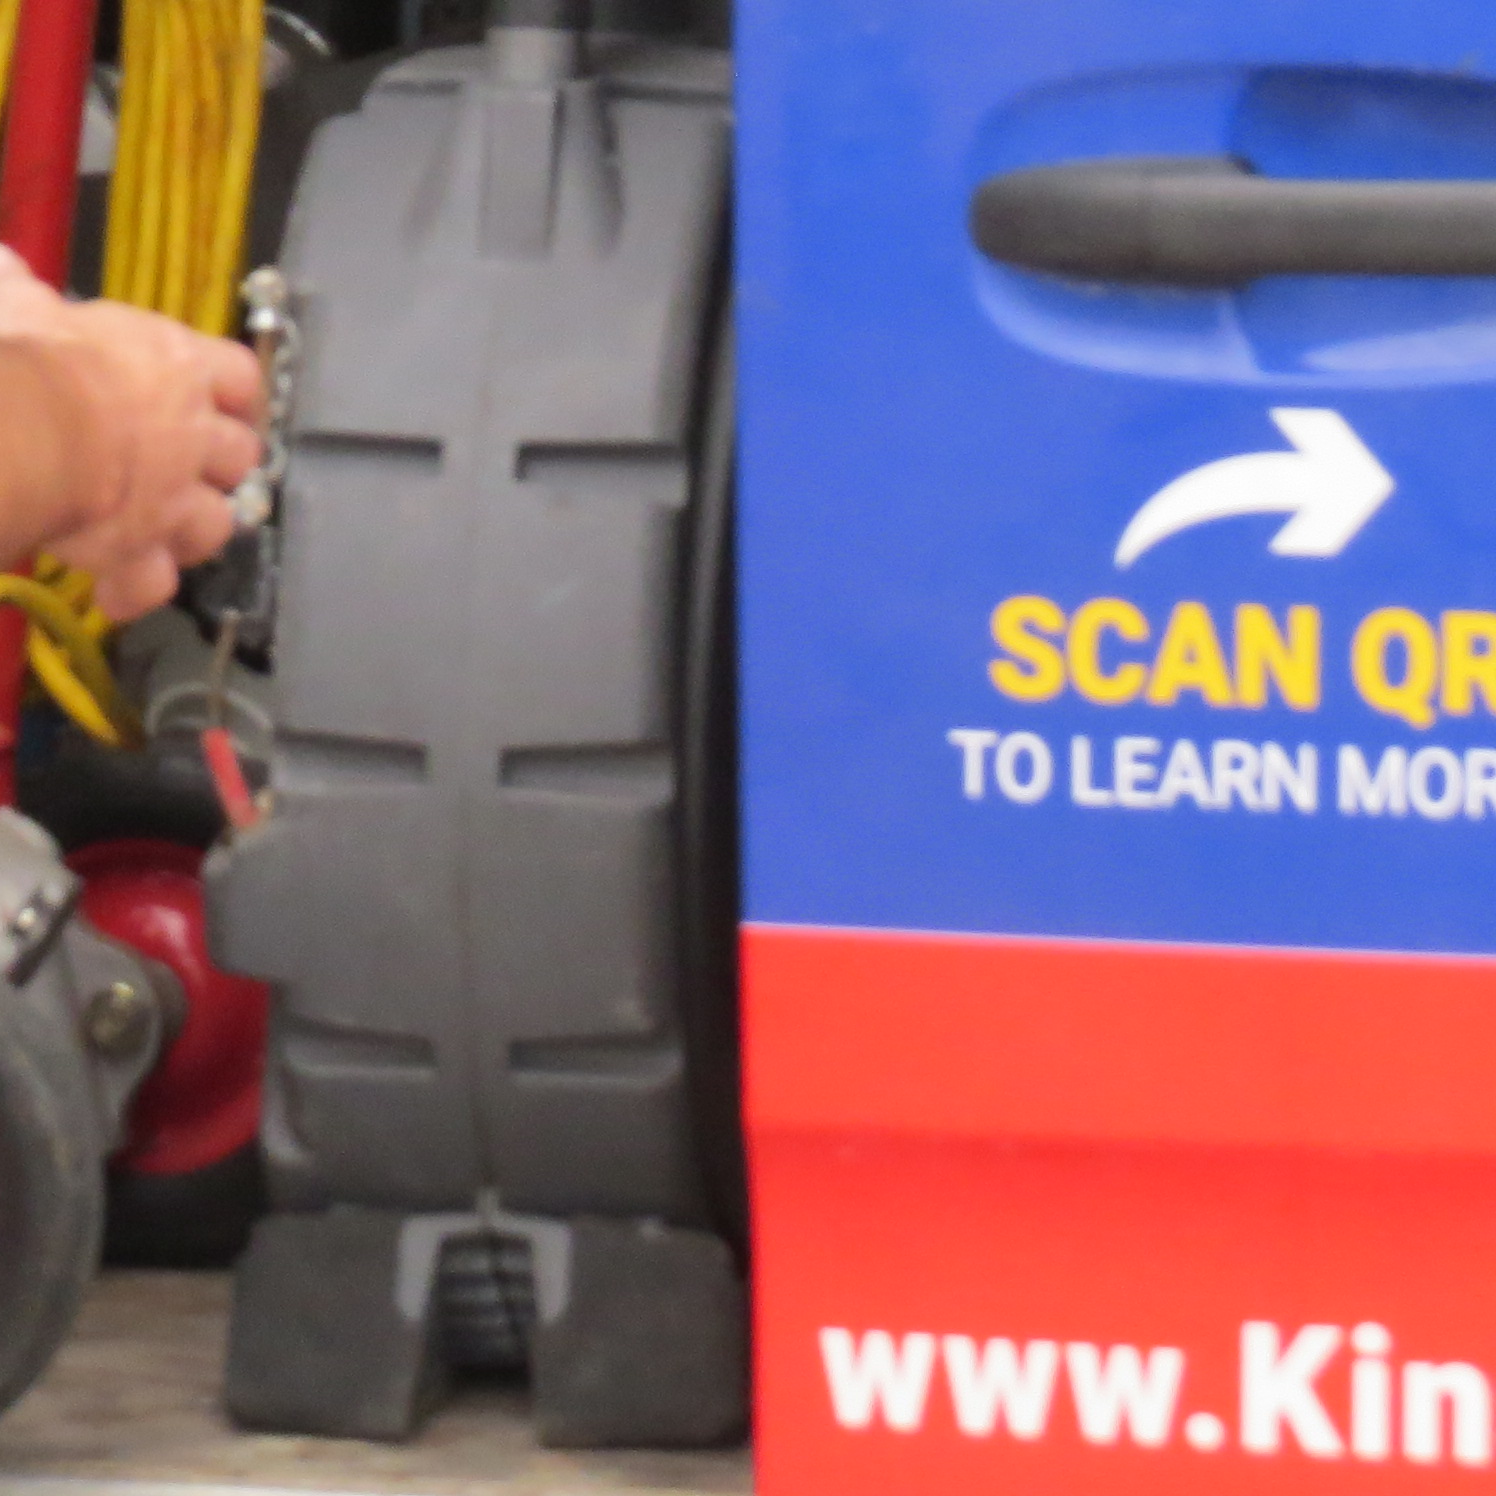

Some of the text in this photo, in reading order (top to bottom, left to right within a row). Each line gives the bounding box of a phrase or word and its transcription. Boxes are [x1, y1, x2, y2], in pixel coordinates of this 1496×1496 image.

[988, 594, 1496, 730] SCAN QR
[947, 728, 1496, 821] TO LEARN MOR
[819, 1320, 1494, 1467] www.Kin
